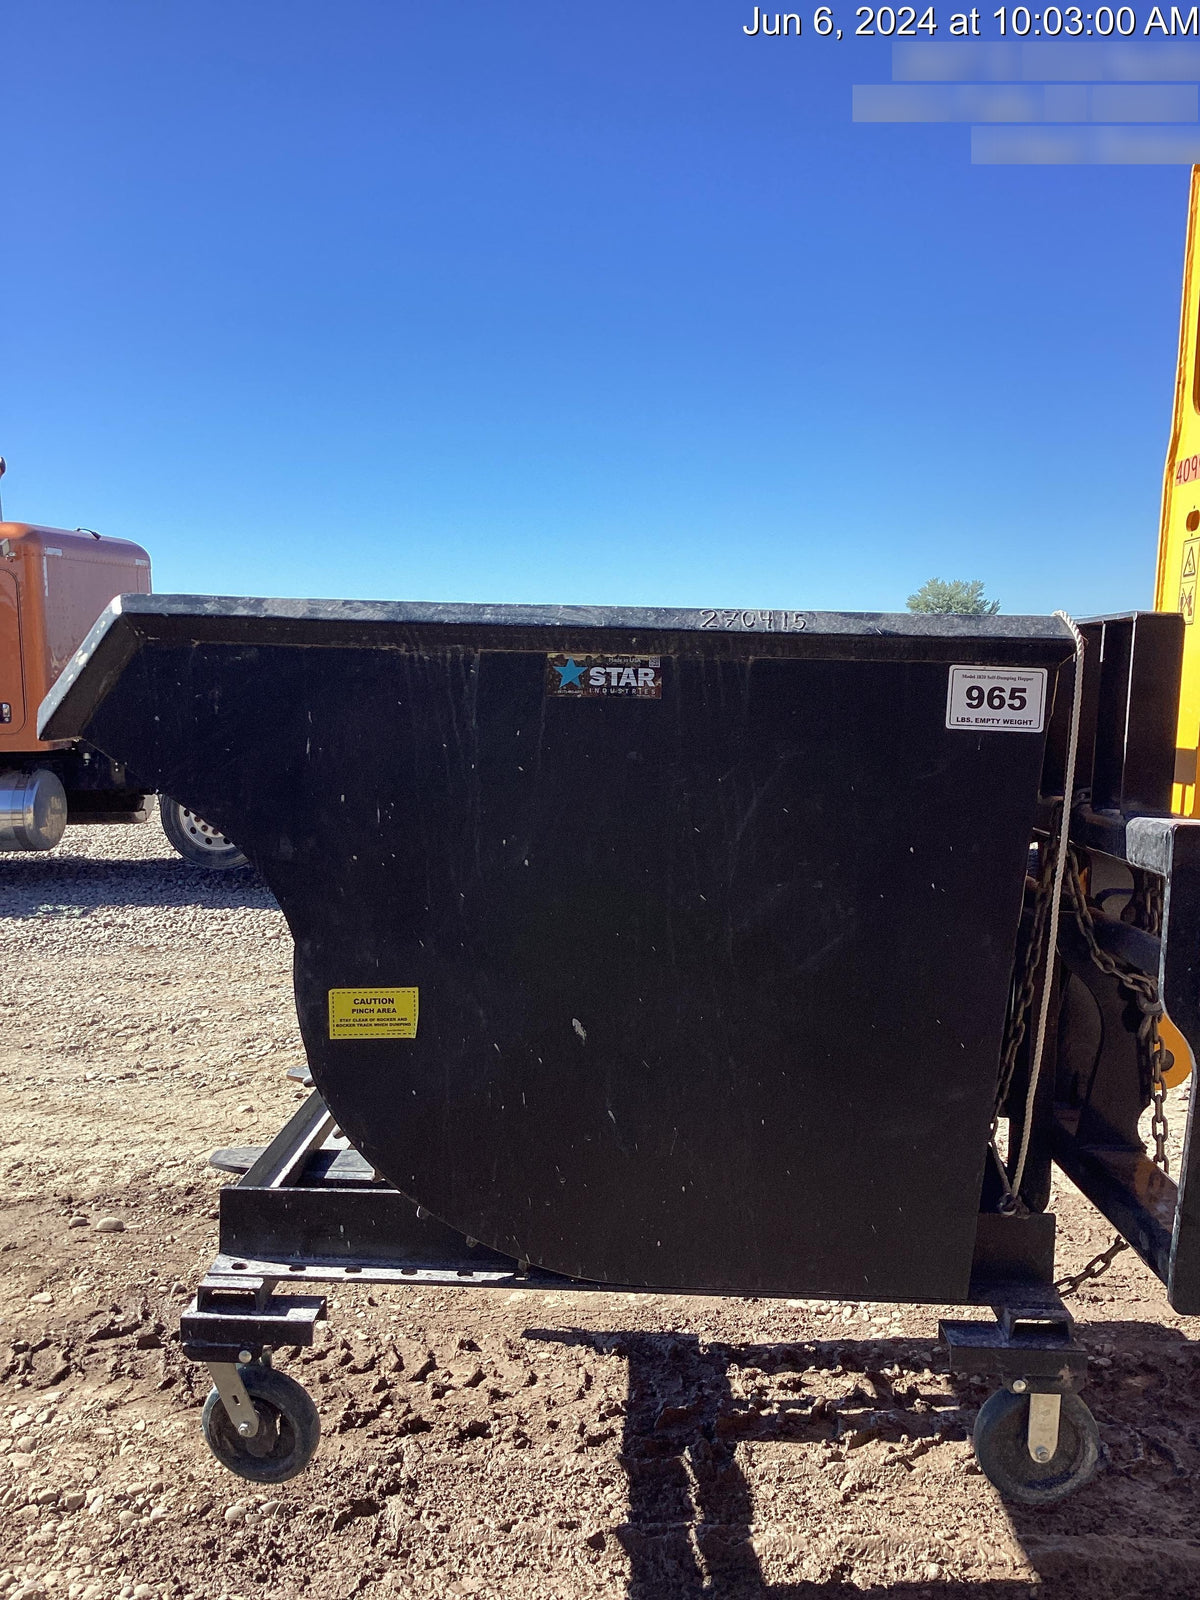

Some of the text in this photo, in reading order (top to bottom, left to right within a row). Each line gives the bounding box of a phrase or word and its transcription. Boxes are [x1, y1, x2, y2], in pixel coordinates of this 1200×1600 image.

[1176, 455, 1200, 484] 409
[701, 610, 807, 631] 270415
[589, 666, 655, 687] STAR
[589, 687, 656, 695] INDUSTRIES
[965, 685, 1027, 711] 965
[956, 716, 1034, 726] LBS. EMPTY WEIGHT
[353, 997, 395, 1006] CAUTION
